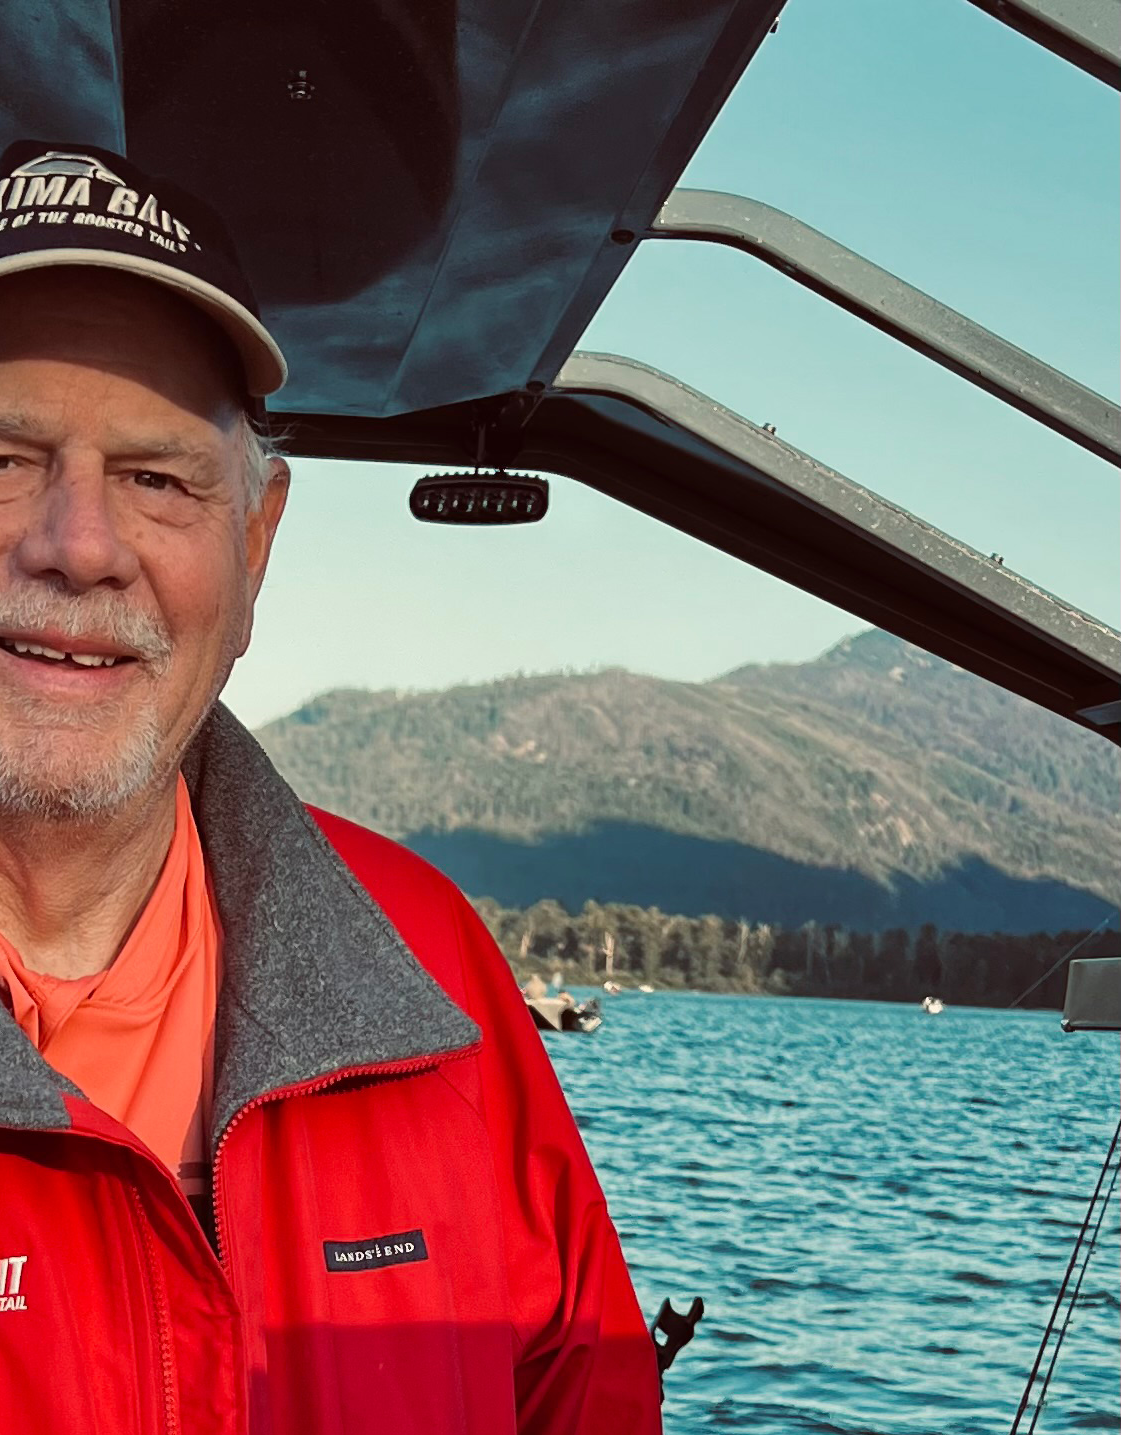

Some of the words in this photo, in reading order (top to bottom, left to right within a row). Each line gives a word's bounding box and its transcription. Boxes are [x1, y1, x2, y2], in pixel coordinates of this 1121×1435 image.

[11, 211, 35, 229] OF
[38, 211, 70, 224] THE
[73, 212, 144, 237] ROOSTER
[107, 186, 190, 242] BAIT
